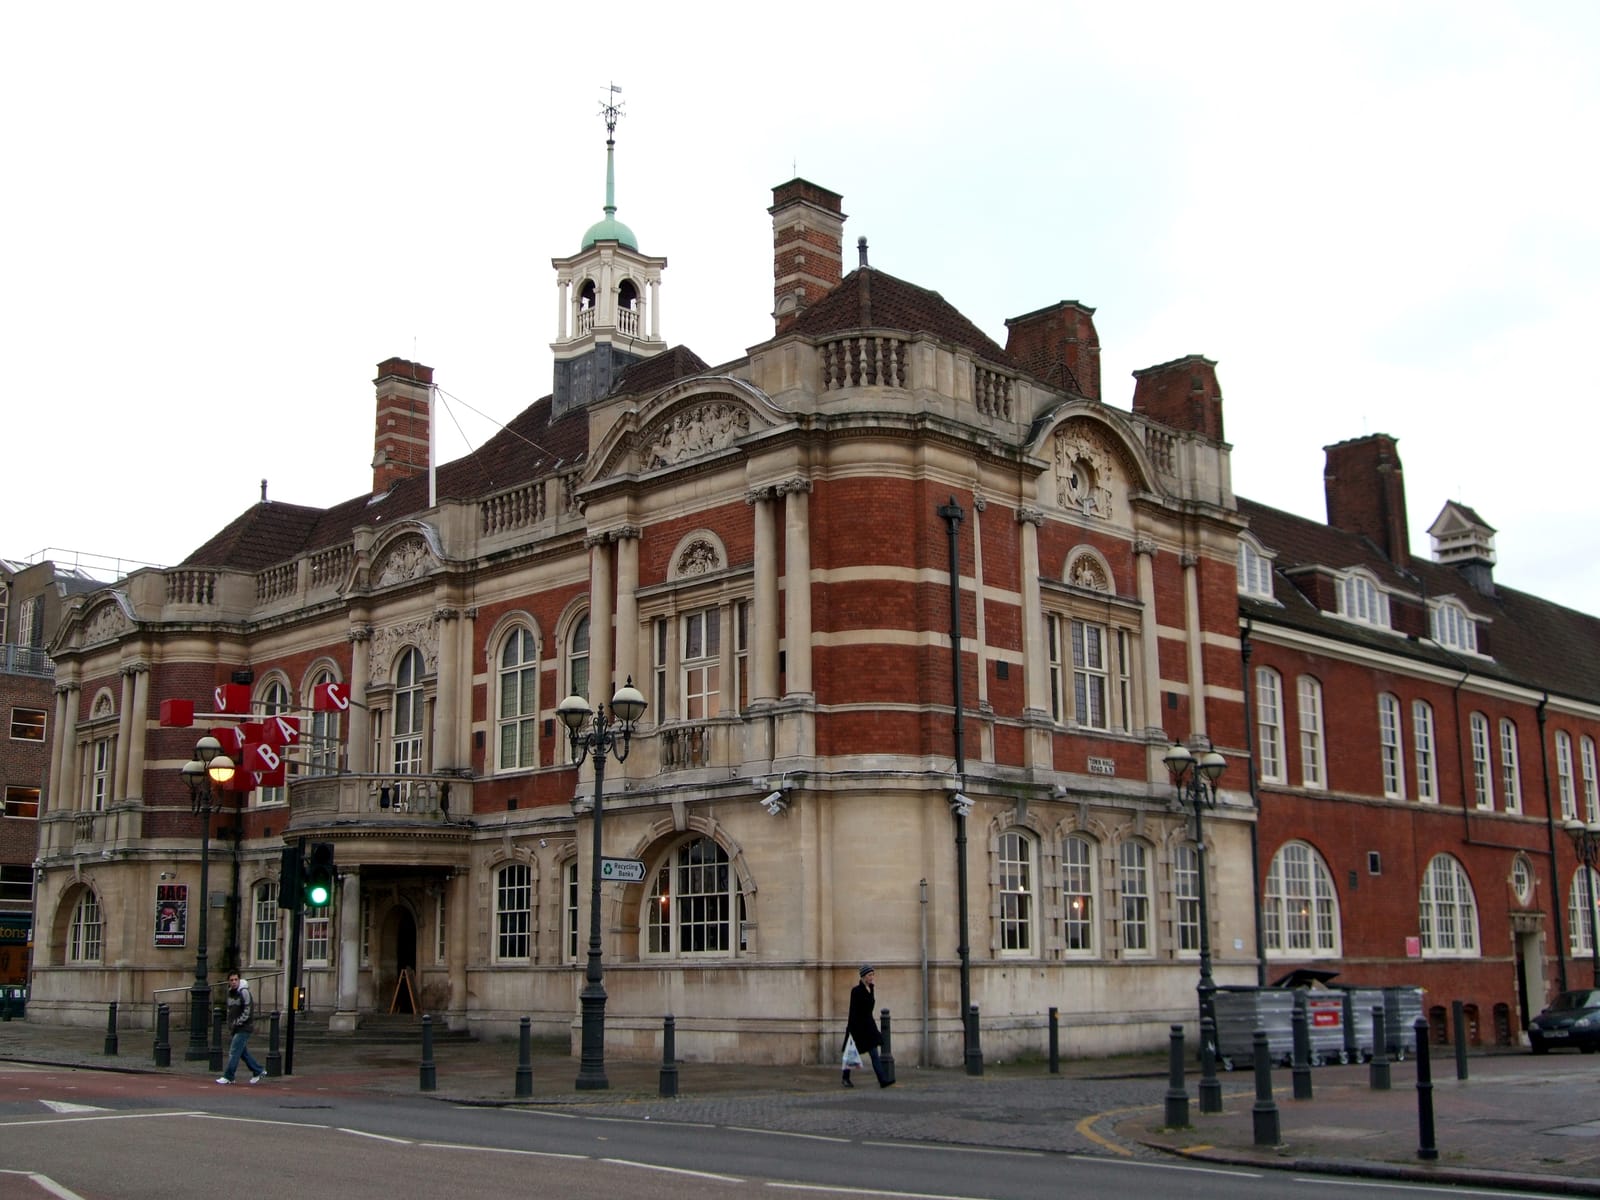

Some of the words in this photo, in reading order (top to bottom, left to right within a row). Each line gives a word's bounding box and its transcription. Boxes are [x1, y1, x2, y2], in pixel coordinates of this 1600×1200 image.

[214, 687, 227, 711] C
[326, 683, 349, 710] C
[233, 725, 246, 748] A
[275, 717, 299, 743] A
[256, 743, 280, 770] B
[614, 862, 639, 871] Recycling
